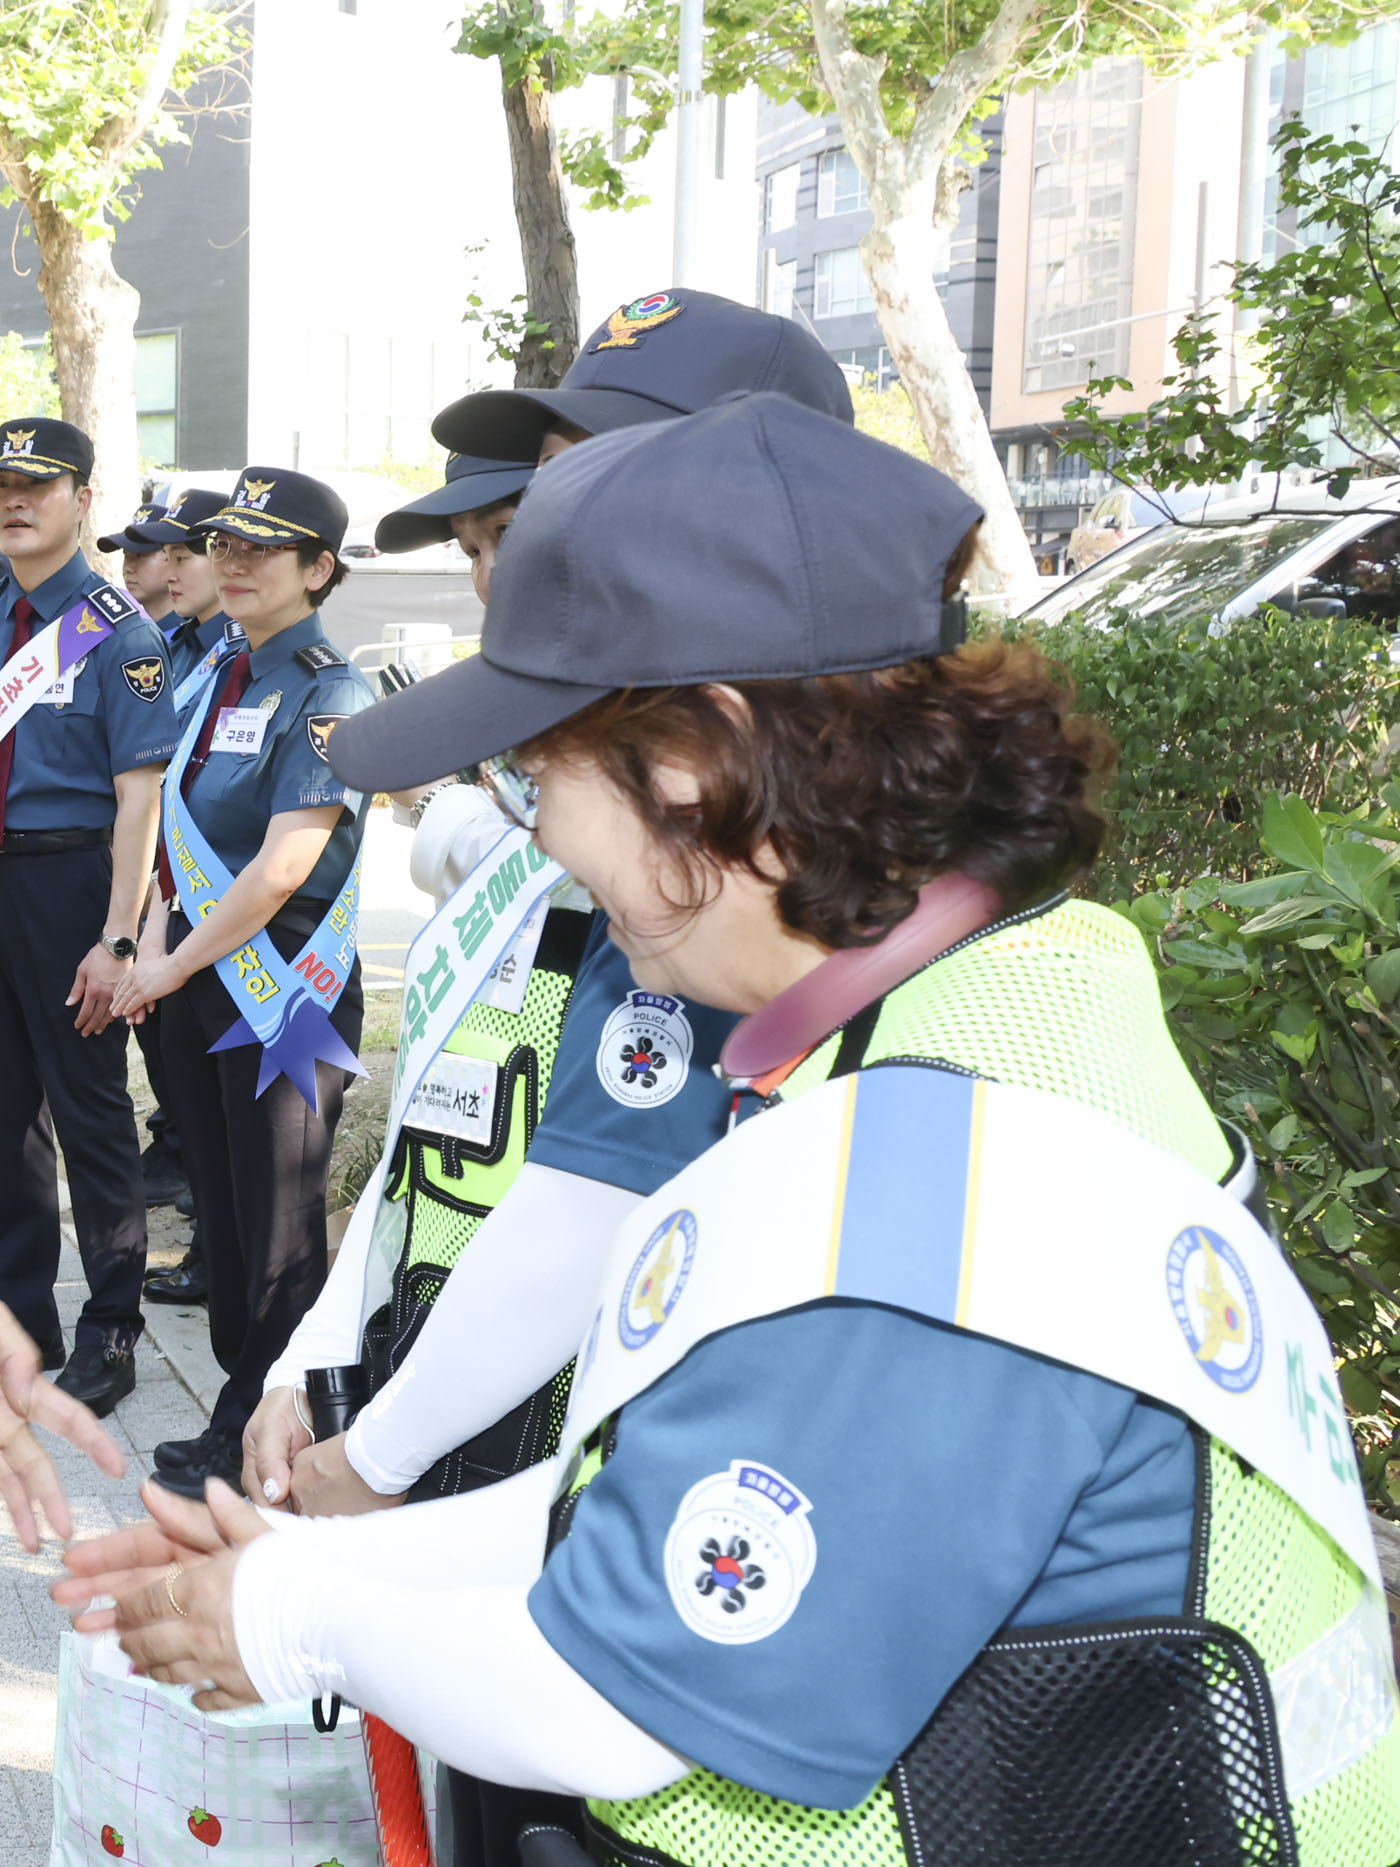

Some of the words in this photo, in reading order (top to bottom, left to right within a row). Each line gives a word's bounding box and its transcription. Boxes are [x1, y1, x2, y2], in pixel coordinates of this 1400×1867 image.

[140, 685, 158, 694] POLICE
[226, 730, 256, 743] 구은영
[294, 950, 343, 1003] NO!
[633, 1012, 668, 1027] POLICE
[452, 1088, 481, 1119] 서초
